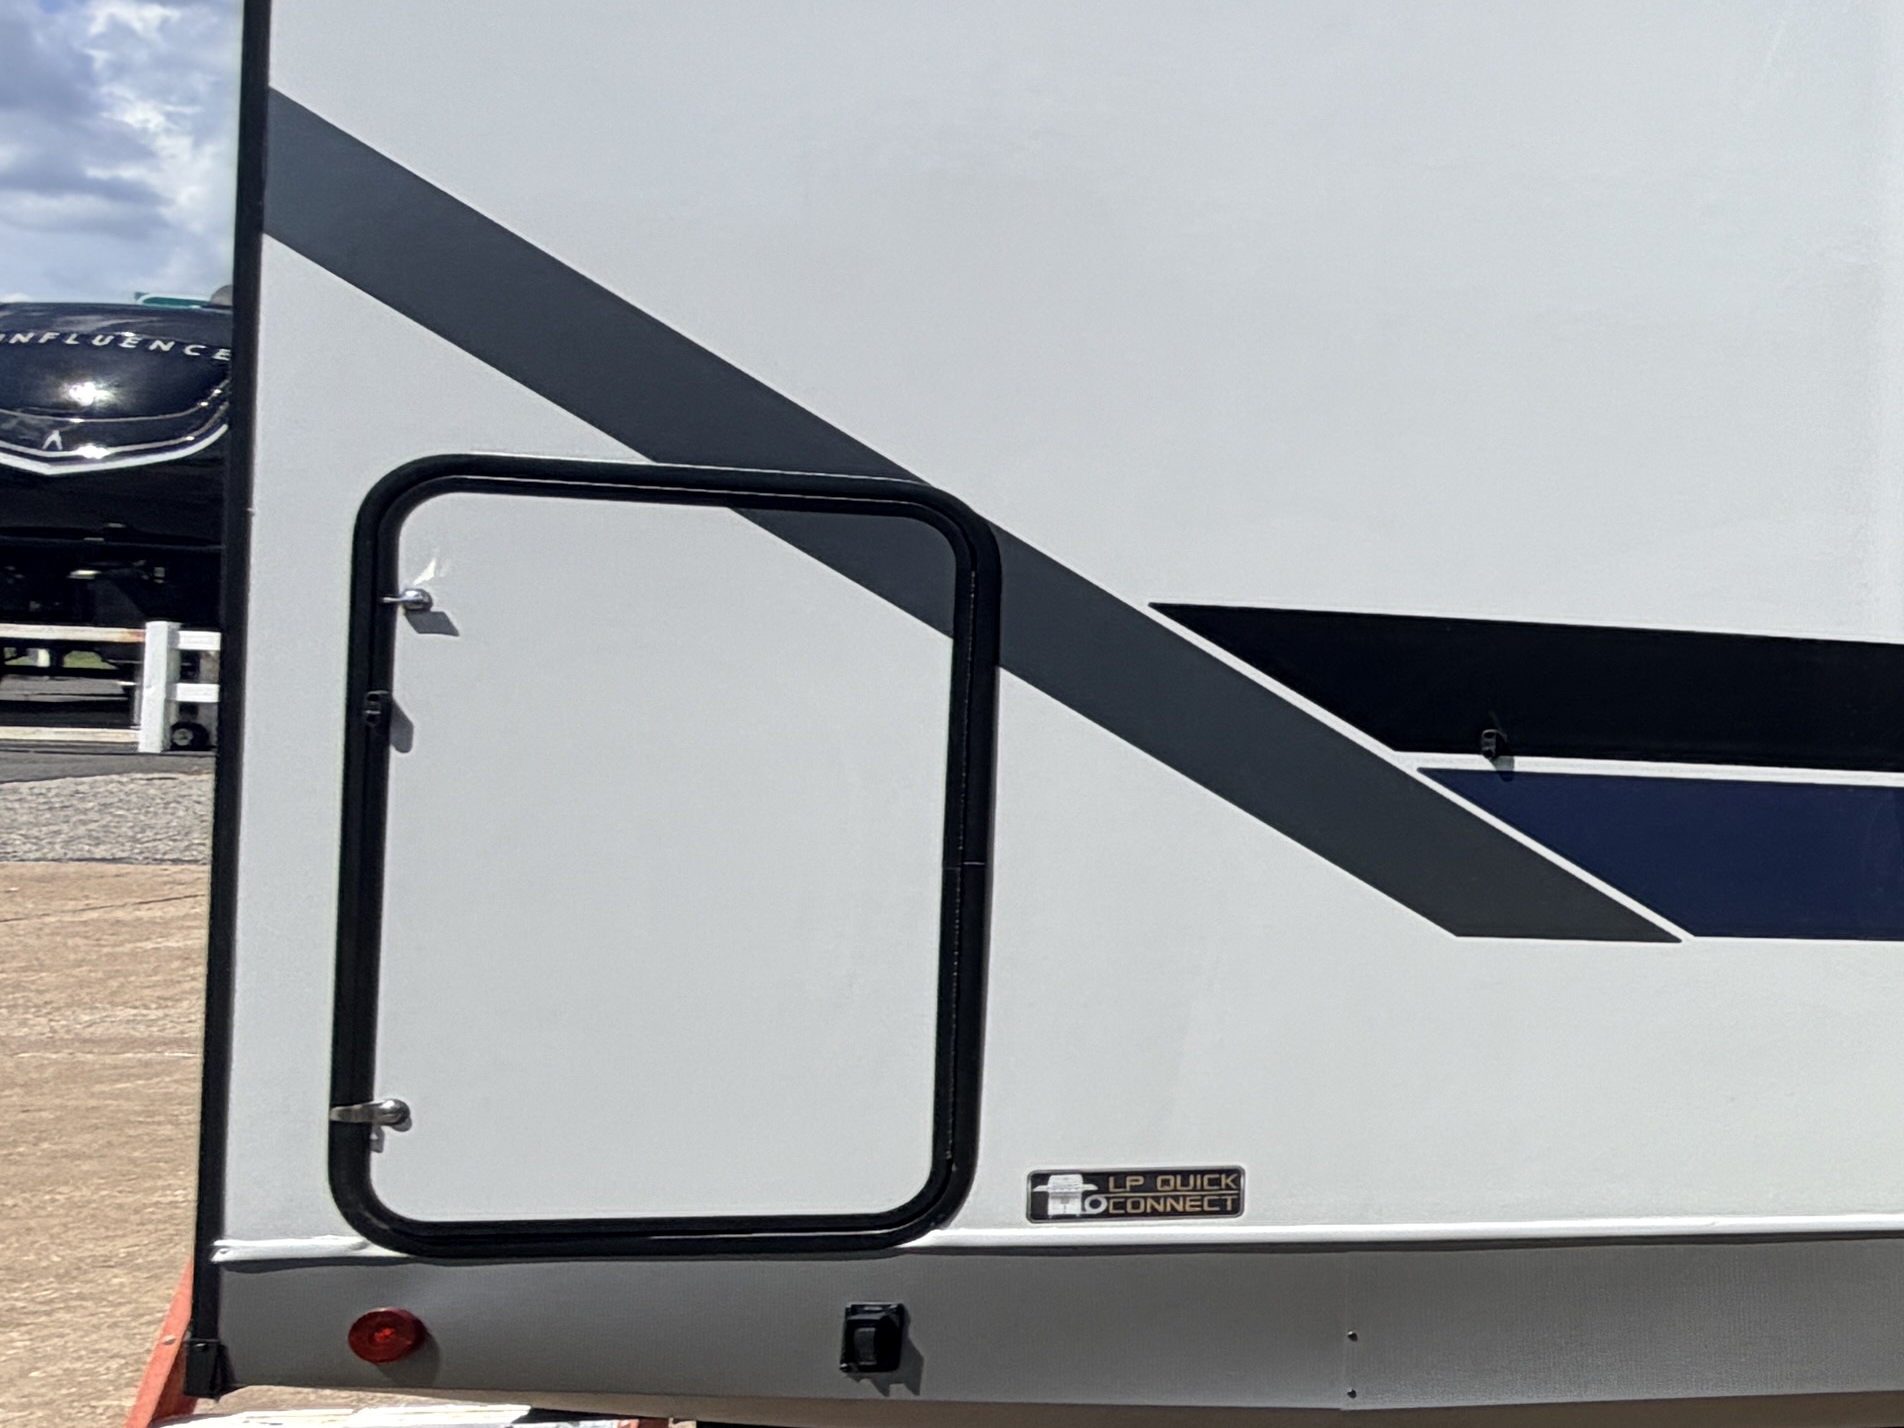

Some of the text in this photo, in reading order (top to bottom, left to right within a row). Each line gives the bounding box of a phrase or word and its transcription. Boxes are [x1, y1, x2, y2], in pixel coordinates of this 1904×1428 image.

[1108, 1173, 1239, 1193] LP QUICK
[1108, 1194, 1239, 1215] CONNECT
